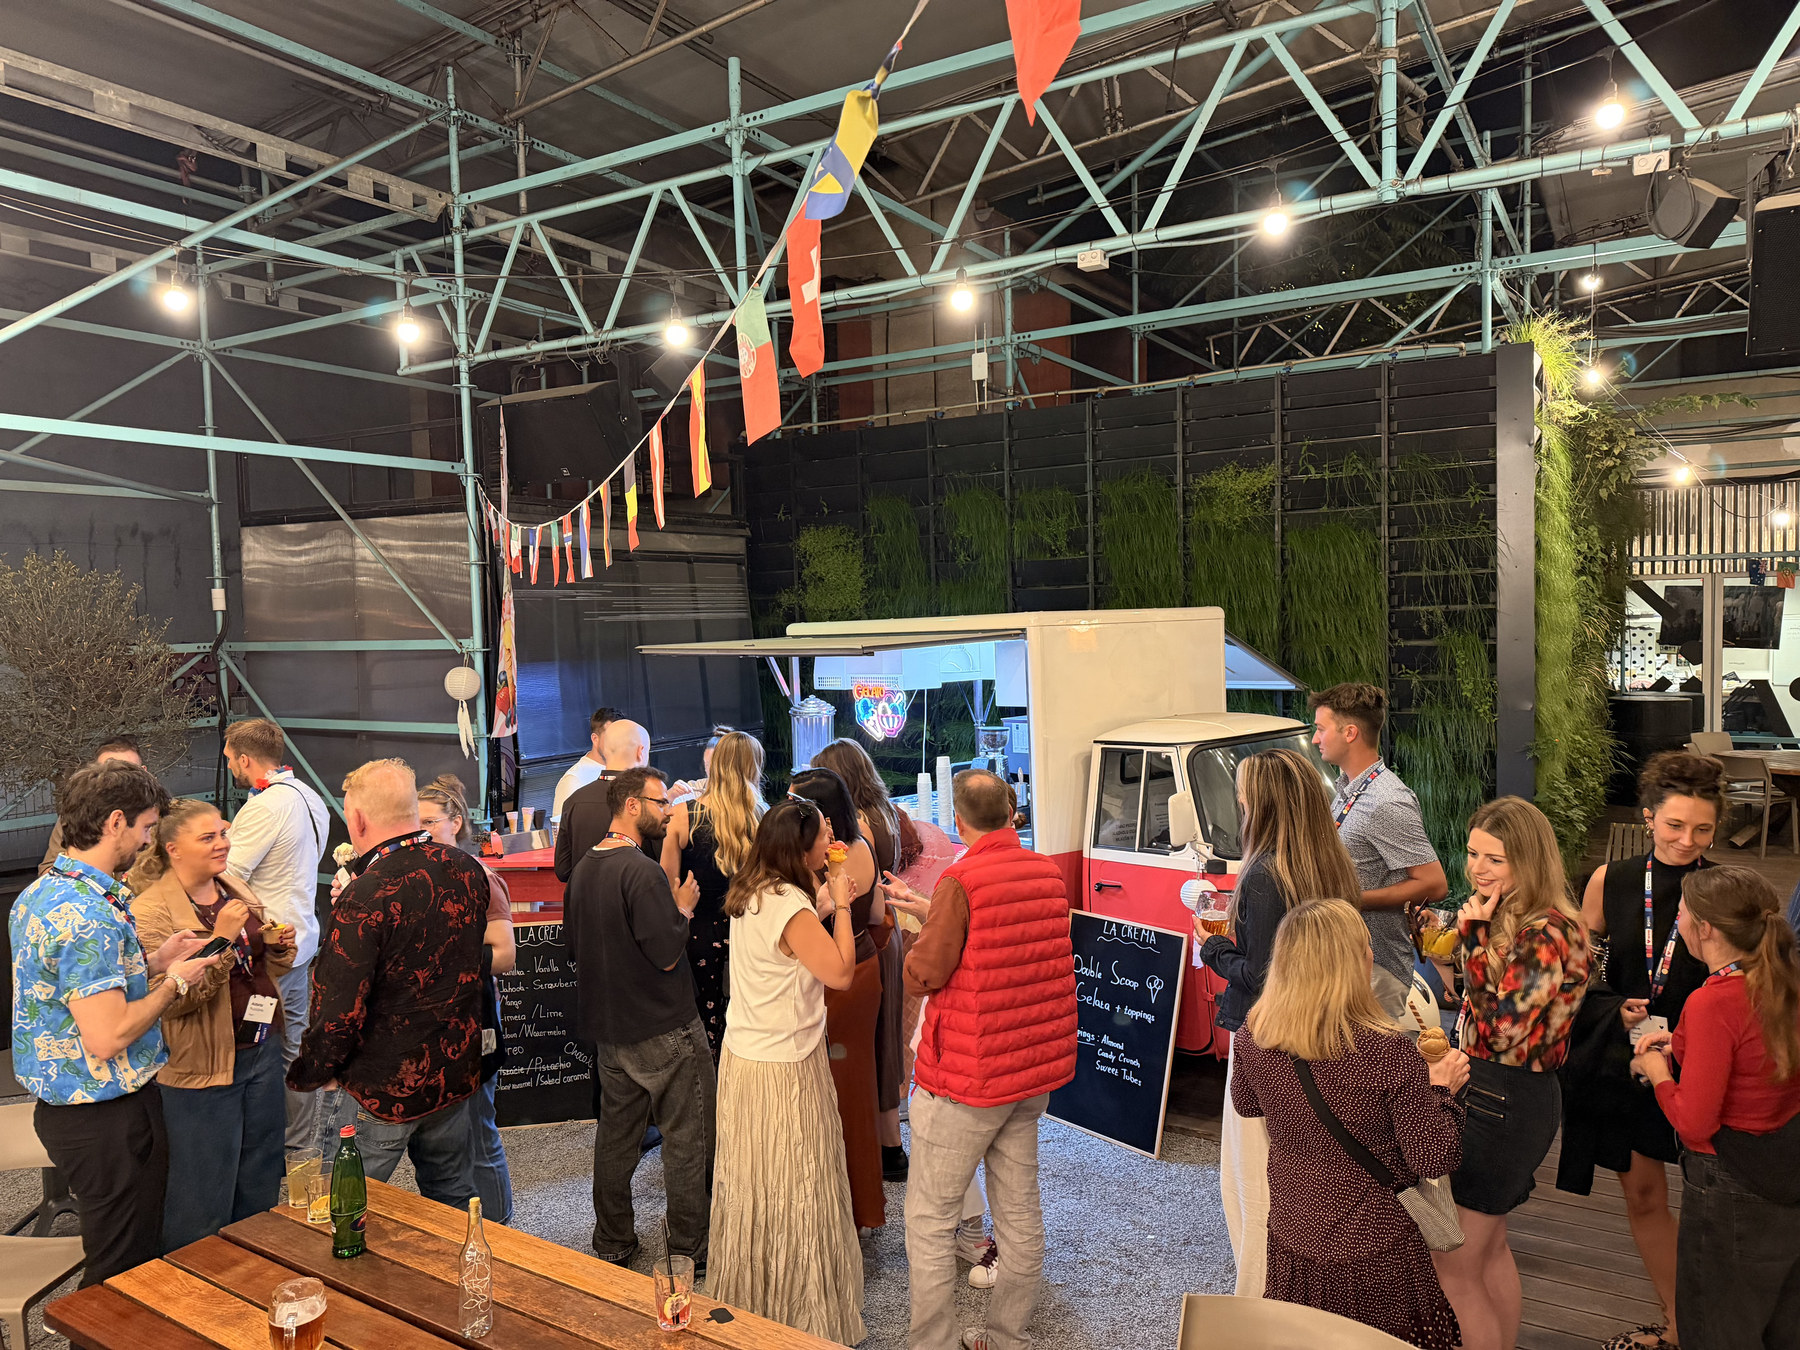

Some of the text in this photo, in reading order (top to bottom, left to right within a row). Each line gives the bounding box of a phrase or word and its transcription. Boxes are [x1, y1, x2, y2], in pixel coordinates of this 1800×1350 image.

[519, 924, 563, 943] LA CREM
[1103, 921, 1156, 944] LA CREMA
[534, 955, 559, 973] Vanilla
[1074, 954, 1139, 990] Double Scoop
[533, 979, 577, 990] Strawberr
[500, 995, 522, 1009] Mango
[1124, 1005, 1155, 1024] toppings
[1077, 1026, 1095, 1042] pings
[1101, 1034, 1124, 1050] Almond
[506, 1046, 524, 1056] reo
[1097, 1048, 1116, 1063] Candy
[562, 1069, 591, 1083] caramel
[1096, 1060, 1142, 1086] Sweet Tubes
